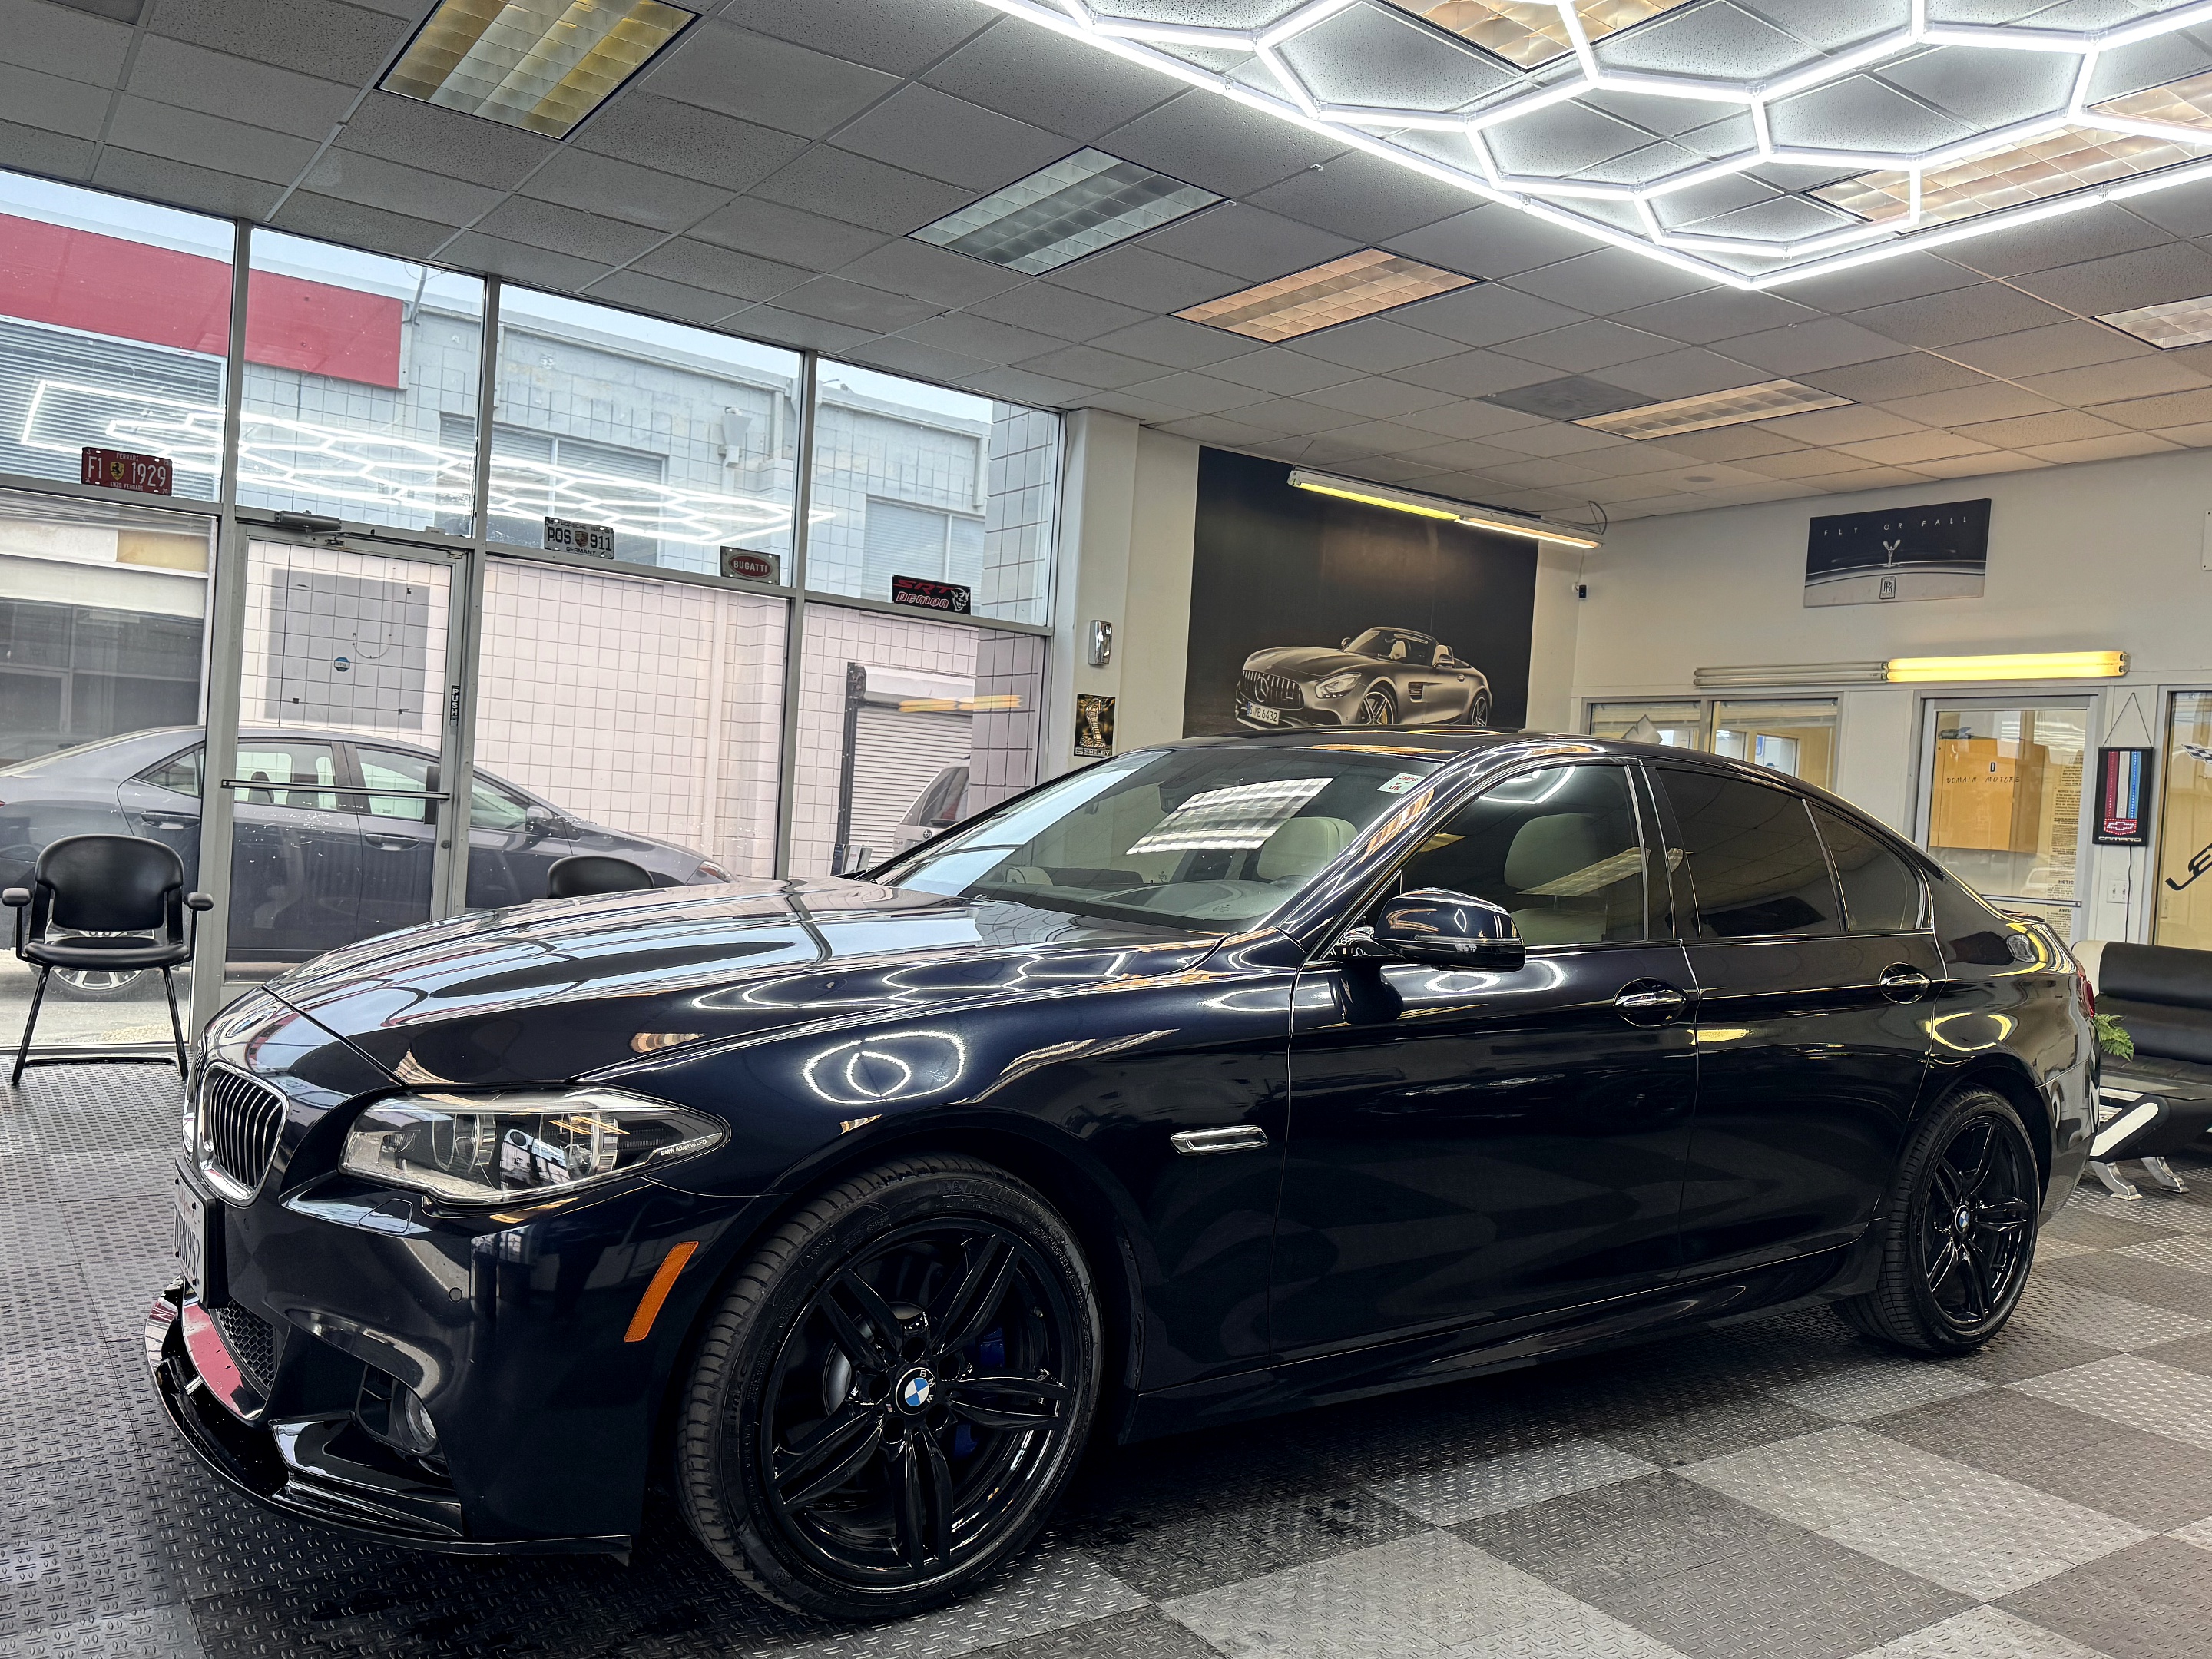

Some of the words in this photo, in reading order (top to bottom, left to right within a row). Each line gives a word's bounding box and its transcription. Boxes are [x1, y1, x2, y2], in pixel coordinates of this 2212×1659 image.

[116, 452, 139, 462] FERRARI
[88, 455, 102, 479] F1
[131, 462, 167, 488] 1929
[124, 483, 144, 492] FERRARI
[561, 520, 587, 530] PORSCHE
[1823, 526, 1859, 536] FLY
[1883, 522, 1903, 531] OR
[1922, 516, 1968, 527] FALL
[548, 526, 571, 545] POS
[590, 533, 612, 551] 911
[565, 546, 596, 555] GERMANY
[733, 560, 767, 573] BUGATTI
[893, 579, 955, 595] SRT
[451, 688, 459, 716] PUSH
[1261, 709, 1278, 723] 6432
[661, 1147, 675, 1156] BMW
[676, 1143, 697, 1152] Adaptive
[919, 1369, 935, 1403] BMW
